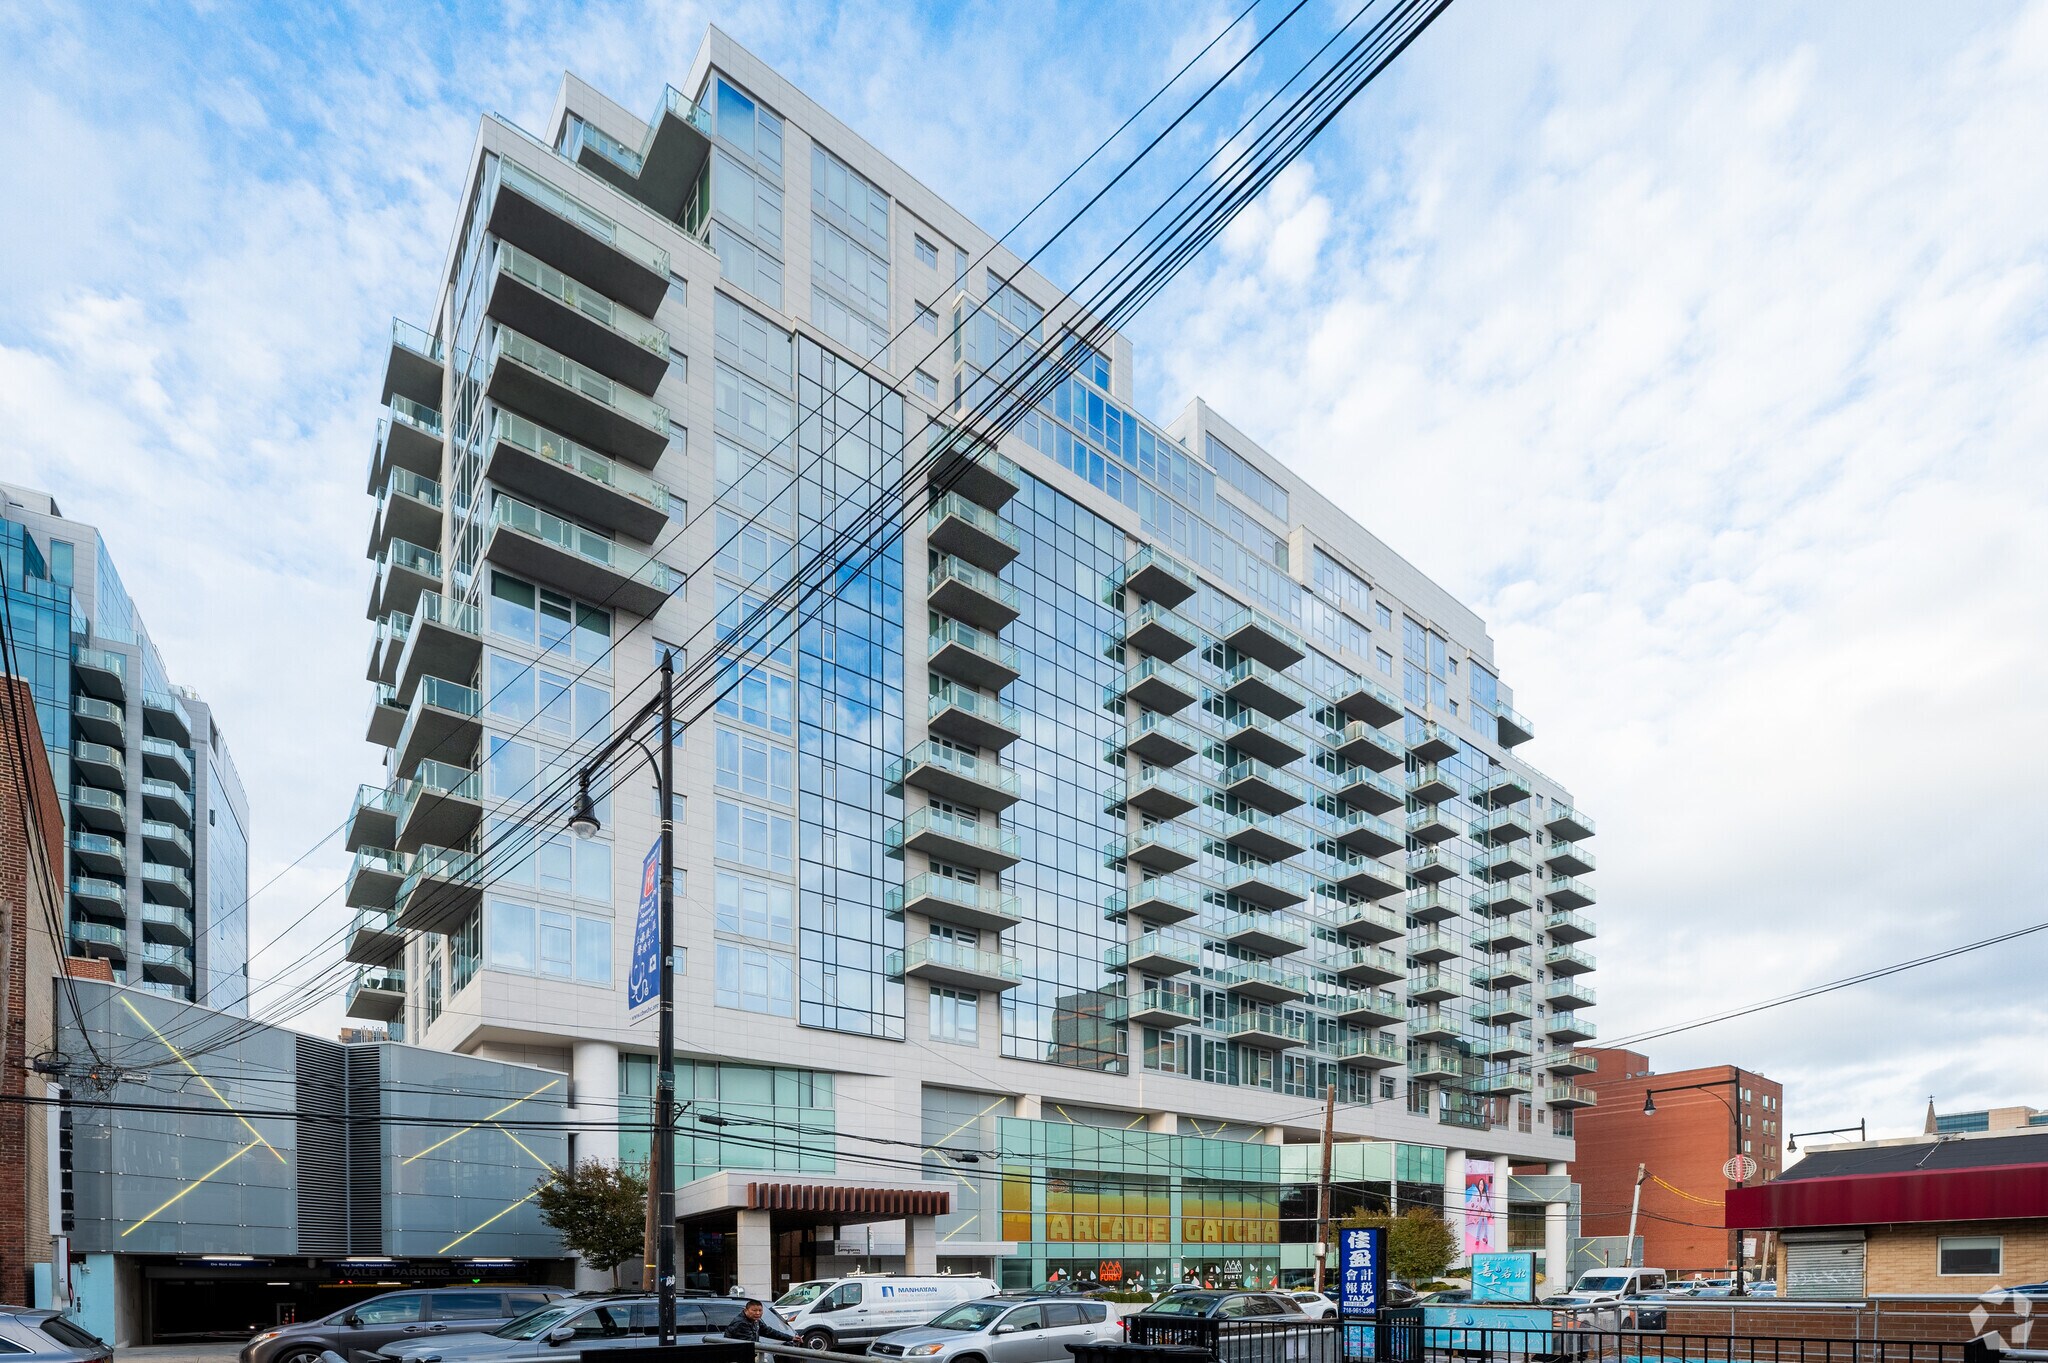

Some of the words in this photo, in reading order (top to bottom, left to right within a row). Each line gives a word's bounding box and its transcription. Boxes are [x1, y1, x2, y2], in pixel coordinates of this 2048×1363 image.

[1050, 1215, 1168, 1241] ARCADE
[1185, 1219, 1279, 1242] GATCHA
[343, 1268, 384, 1277] VALET
[392, 1268, 450, 1276] PARKING
[457, 1268, 487, 1276] ONLY
